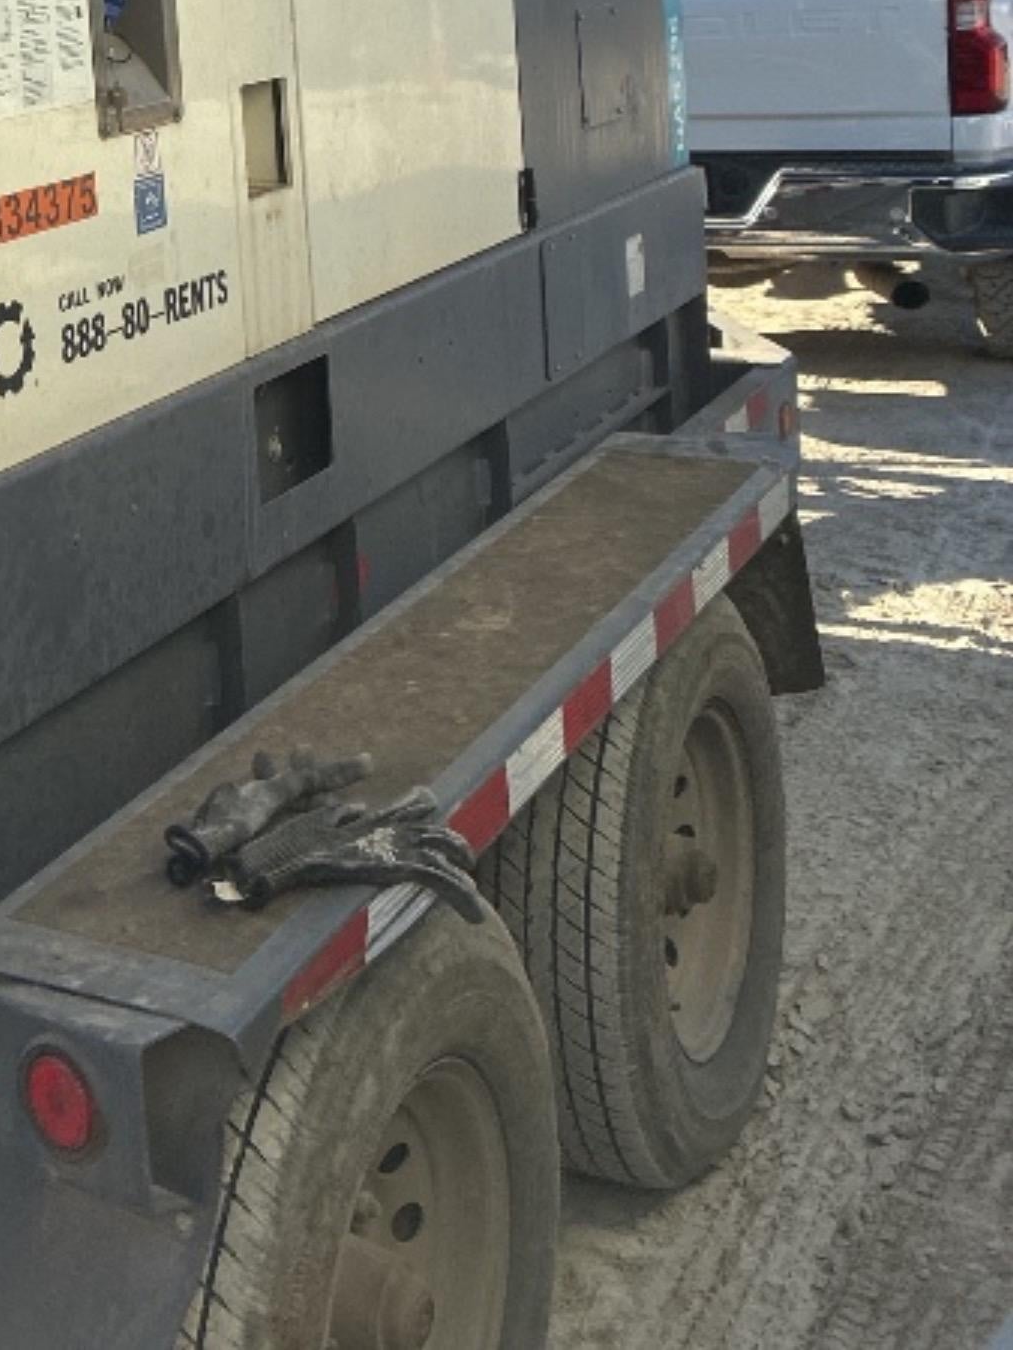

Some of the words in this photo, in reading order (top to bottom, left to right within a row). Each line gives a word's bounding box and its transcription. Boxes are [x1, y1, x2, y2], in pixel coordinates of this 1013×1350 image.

[58, 287, 91, 313] CALL
[96, 274, 125, 300] NOW
[61, 269, 229, 364] 888-80-RENTS
